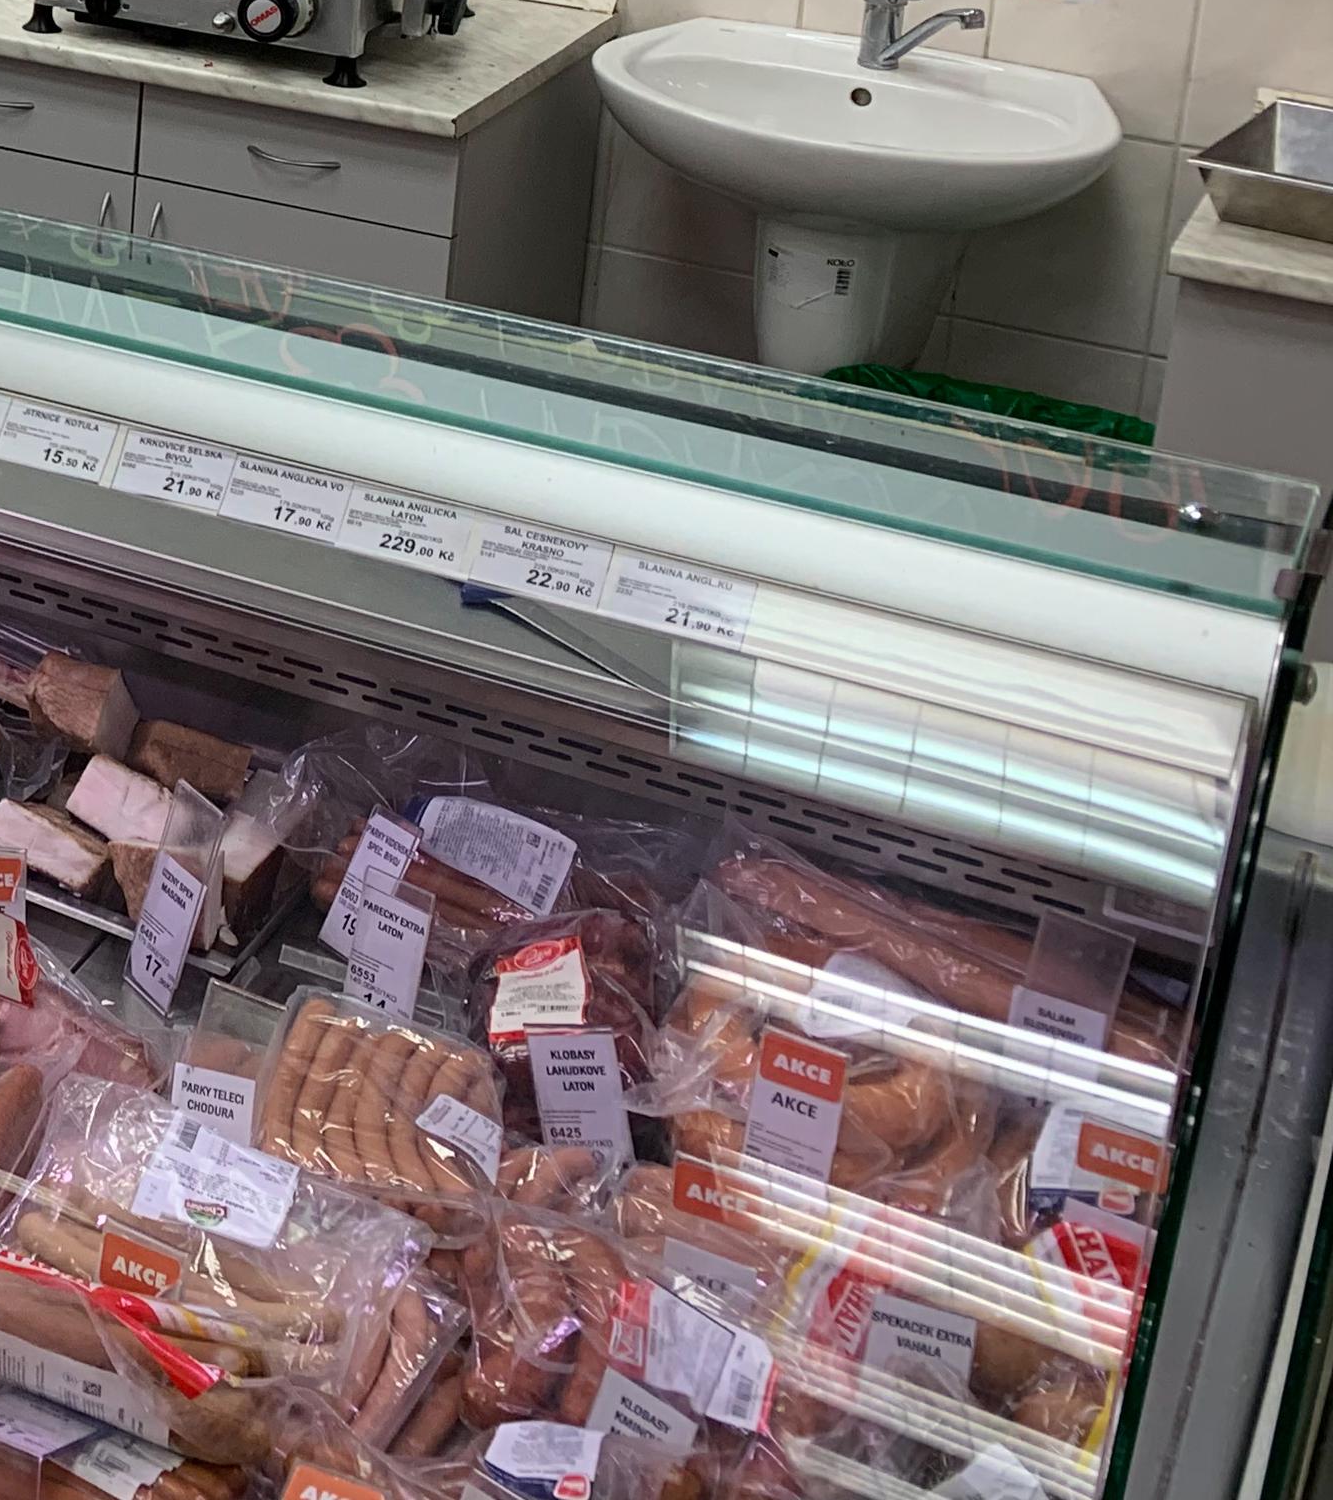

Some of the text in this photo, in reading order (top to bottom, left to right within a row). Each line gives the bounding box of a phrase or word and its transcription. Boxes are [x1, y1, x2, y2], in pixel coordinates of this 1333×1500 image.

[239, 460, 280, 478] SLANINA
[163, 476, 202, 498] 21,90
[273, 505, 312, 529] 17,90
[364, 493, 457, 521] SLANINA ANGLICKA
[390, 510, 424, 524] LATON
[379, 533, 455, 562] 229,00 Kč
[504, 525, 589, 553] SAL CESNEKOVY
[521, 540, 564, 558] KRASNO
[638, 560, 683, 581] SLANINA
[525, 569, 592, 598] 22,90 Kč
[664, 608, 712, 633] 21,90
[362, 898, 425, 937] PARECKY EXTRA
[377, 920, 404, 942] LATON
[145, 954, 162, 977] 17
[350, 964, 375, 984] 6553
[550, 1048, 596, 1061] KLOBASY
[546, 1064, 606, 1077] LAHUDKOVE
[773, 1053, 831, 1087] AKCE
[181, 1079, 245, 1105] PARKY TELECI
[563, 1080, 595, 1092] LATON
[186, 1098, 235, 1122] CHODURA
[771, 1091, 818, 1120] AKCE
[550, 1125, 582, 1139] 6425
[1090, 1142, 1155, 1173] AKCE
[111, 1255, 168, 1289] AKCE
[896, 1338, 943, 1359] VAHALA
[936, 1327, 973, 1349] EXTRA
